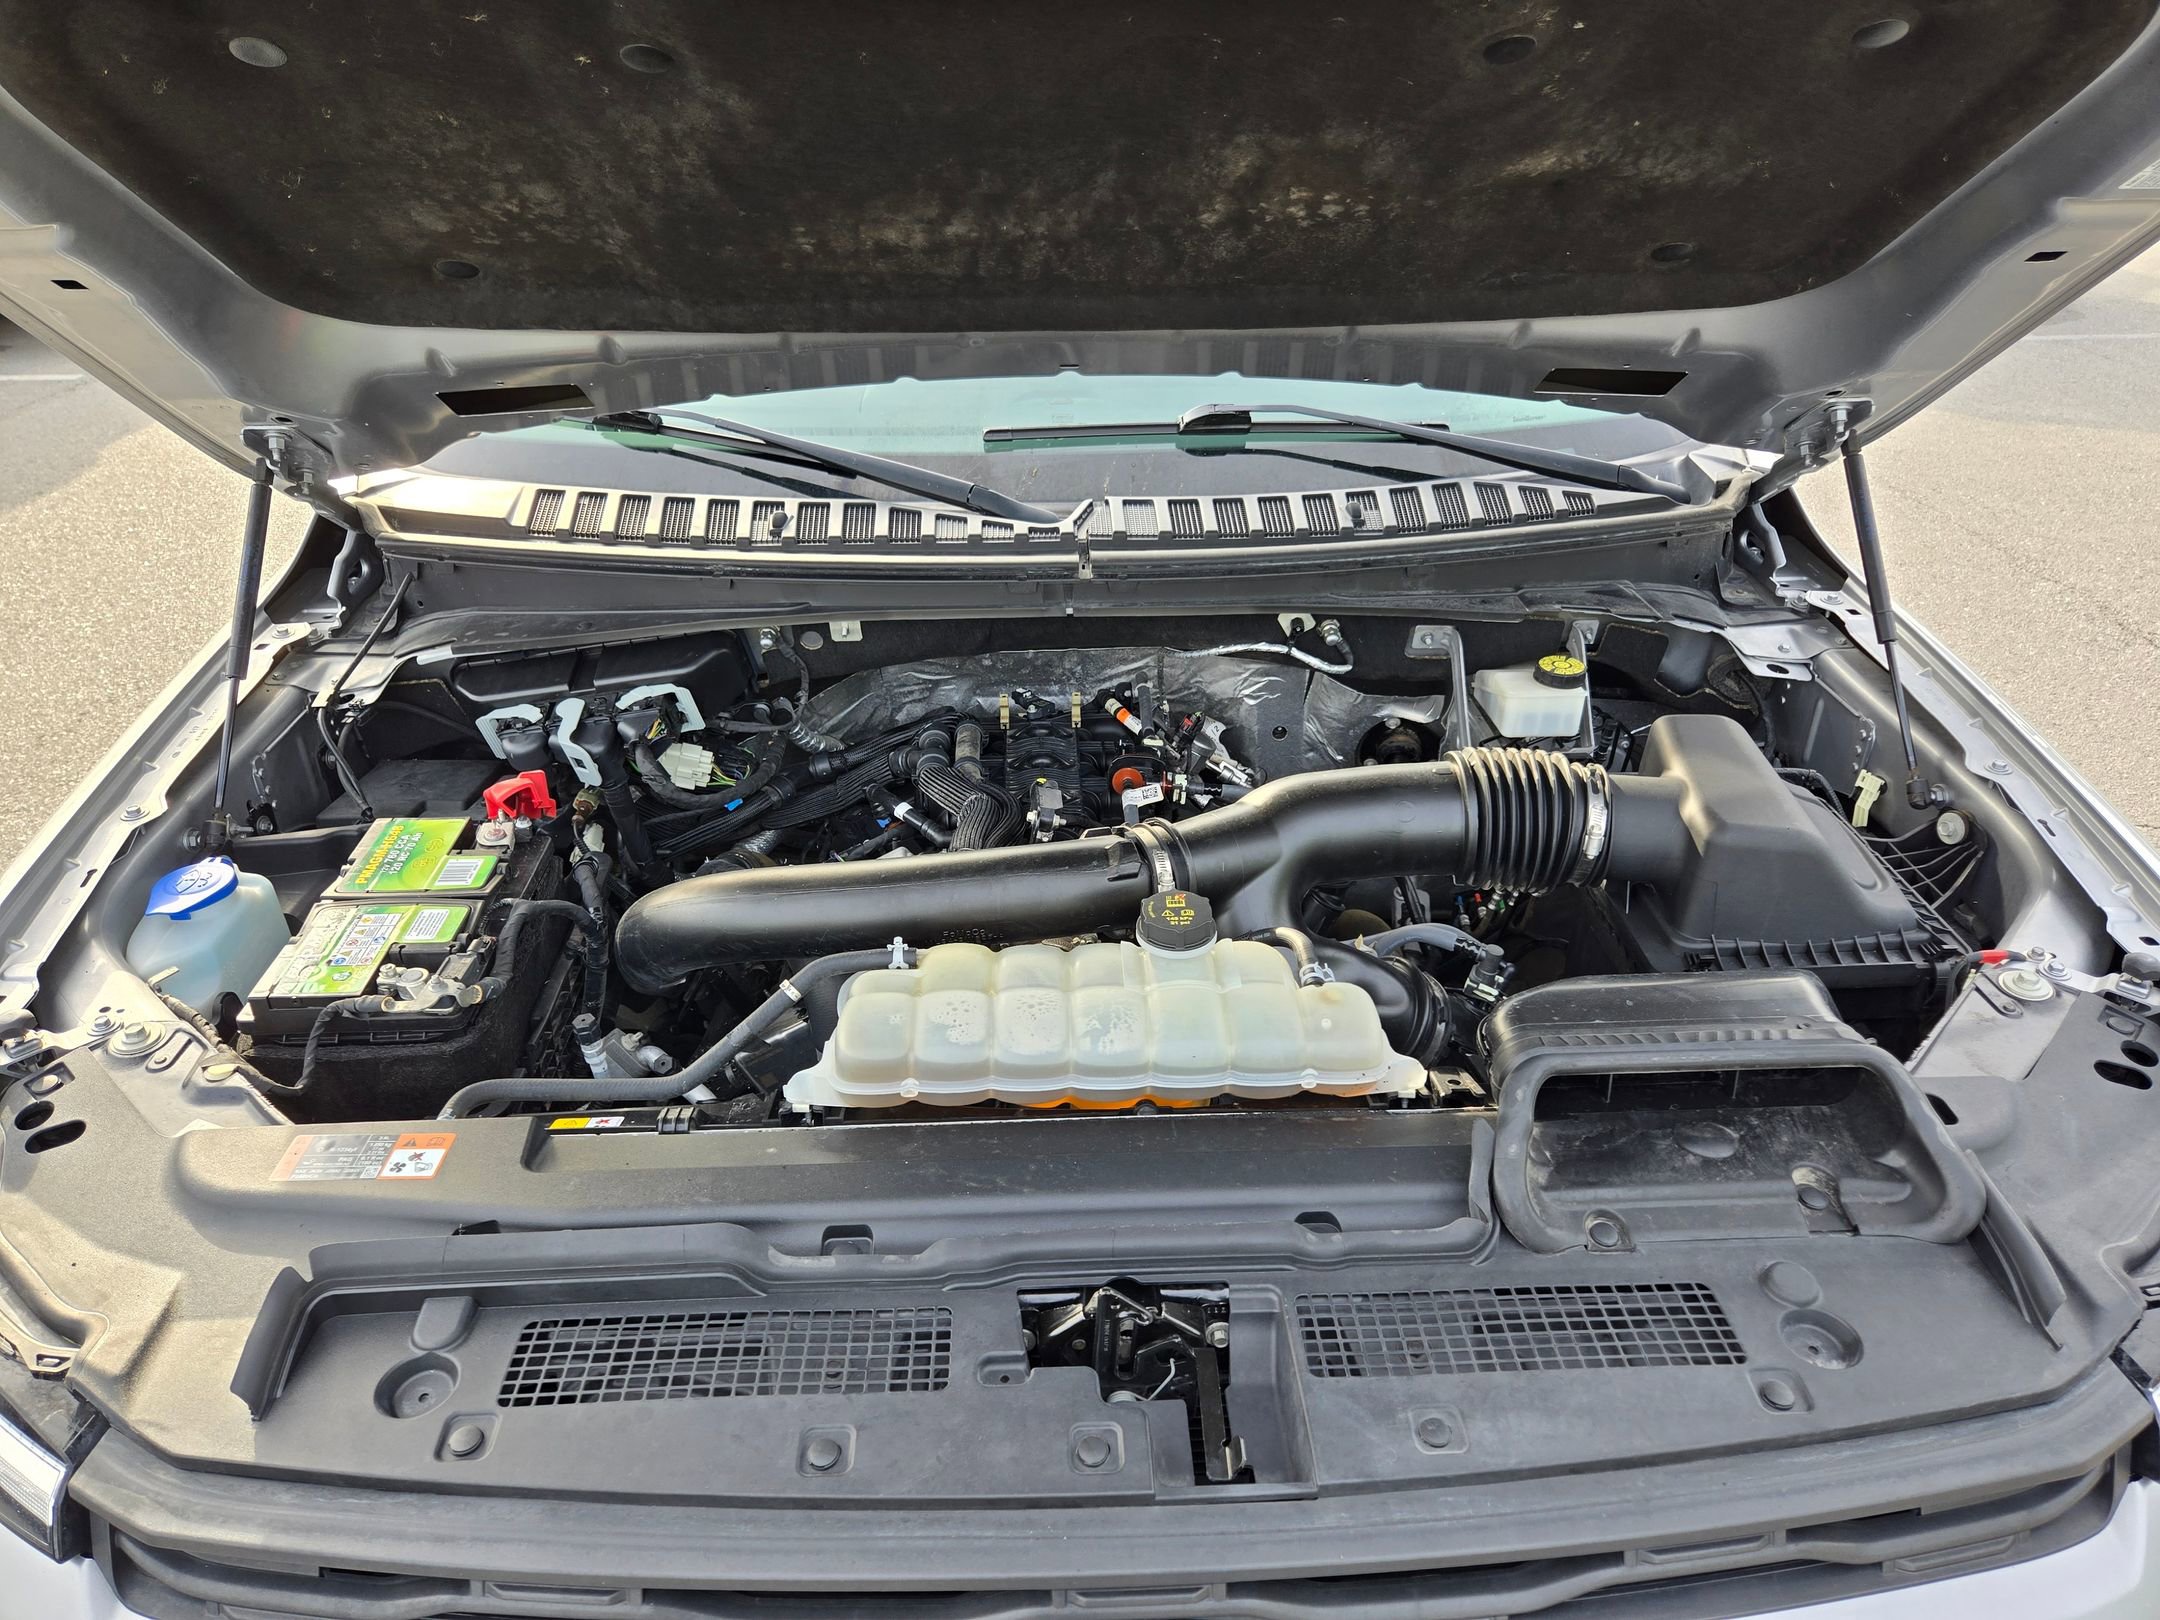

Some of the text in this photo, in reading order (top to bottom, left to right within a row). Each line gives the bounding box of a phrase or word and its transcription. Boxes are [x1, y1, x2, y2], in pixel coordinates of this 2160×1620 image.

[384, 850, 400, 863] 760
[395, 835, 411, 849] CCA
[388, 832, 424, 875] 120 RC 70 Ah
